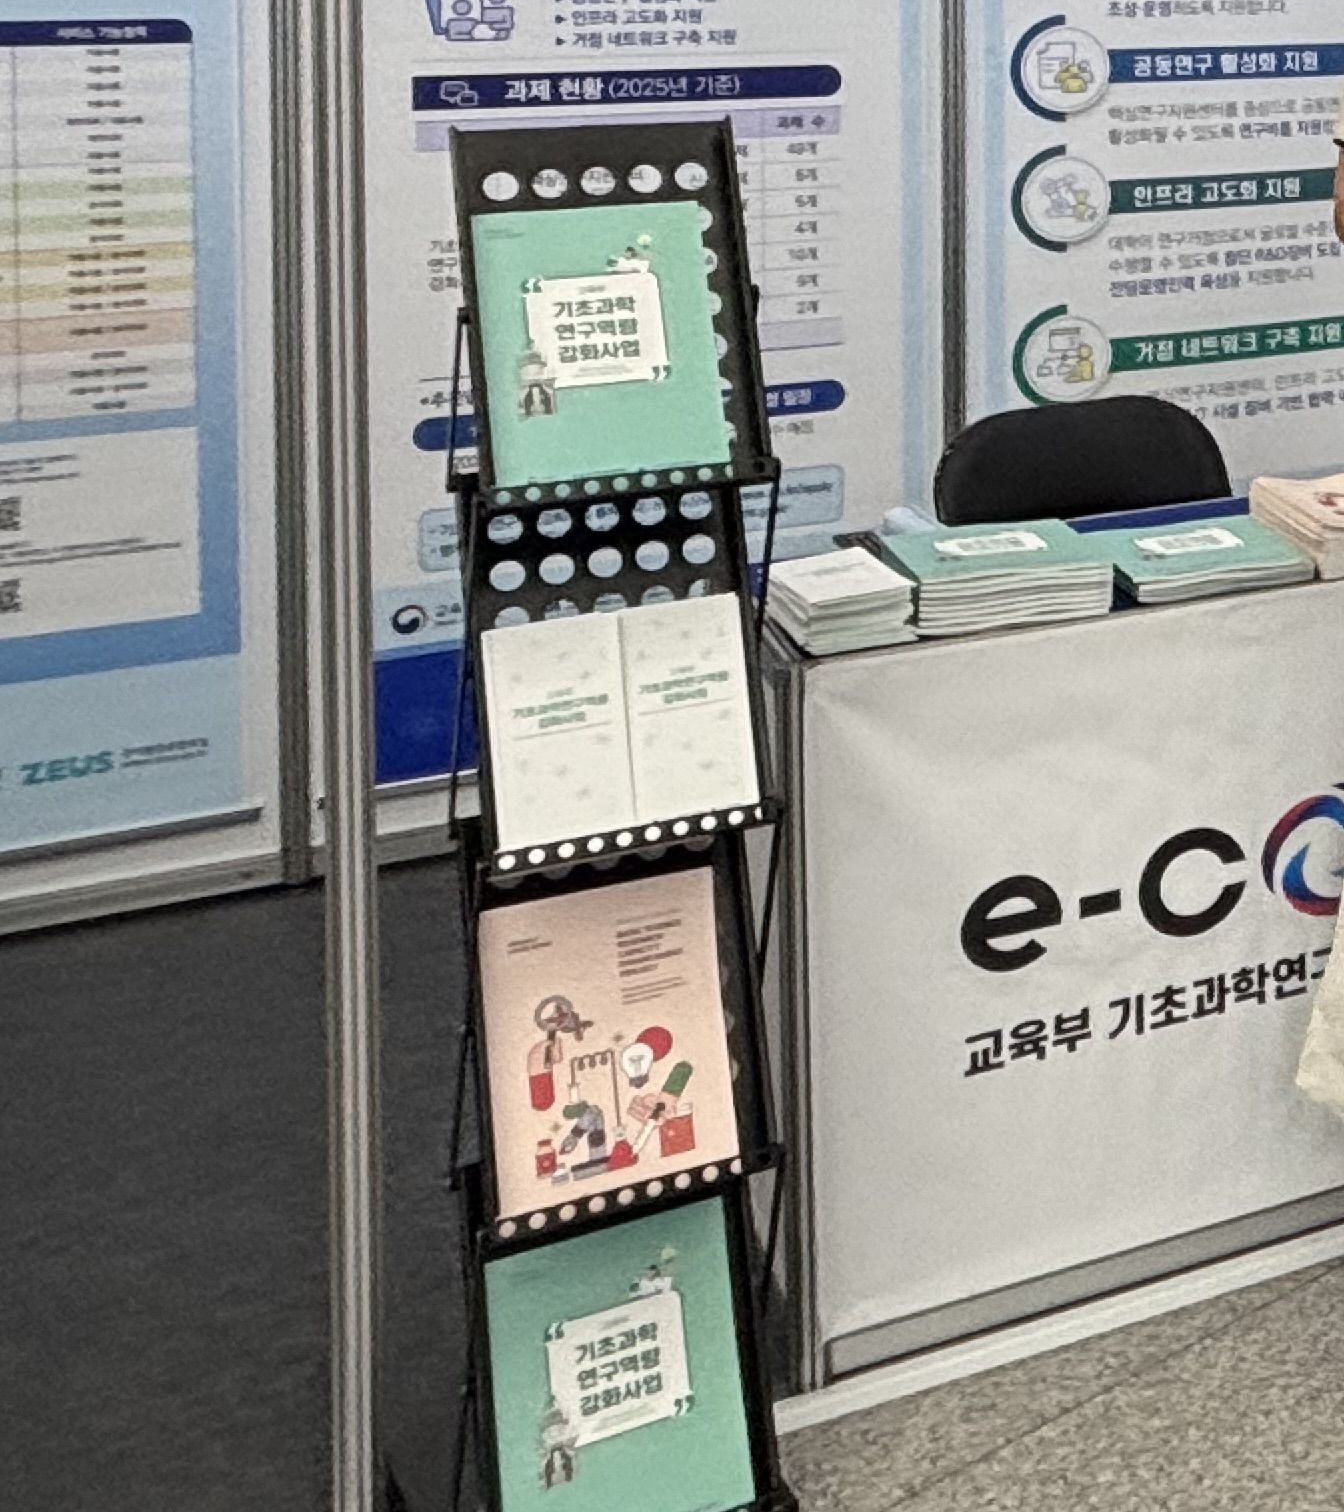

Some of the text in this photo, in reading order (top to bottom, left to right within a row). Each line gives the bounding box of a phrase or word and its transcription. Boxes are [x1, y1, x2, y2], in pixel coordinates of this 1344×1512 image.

[1134, 50, 1319, 77] 공동연구 활성화 지원
[504, 74, 741, 101] 과제 현황 (2025년 기준)
[1134, 177, 1301, 208] 인프라 고도화 지원
[553, 297, 636, 319] 기초과학
[1181, 335, 1258, 359] 네트워크
[1309, 323, 1343, 344] 지원
[963, 1005, 1092, 1078] 교육부
[574, 1321, 658, 1363] 기초과학
